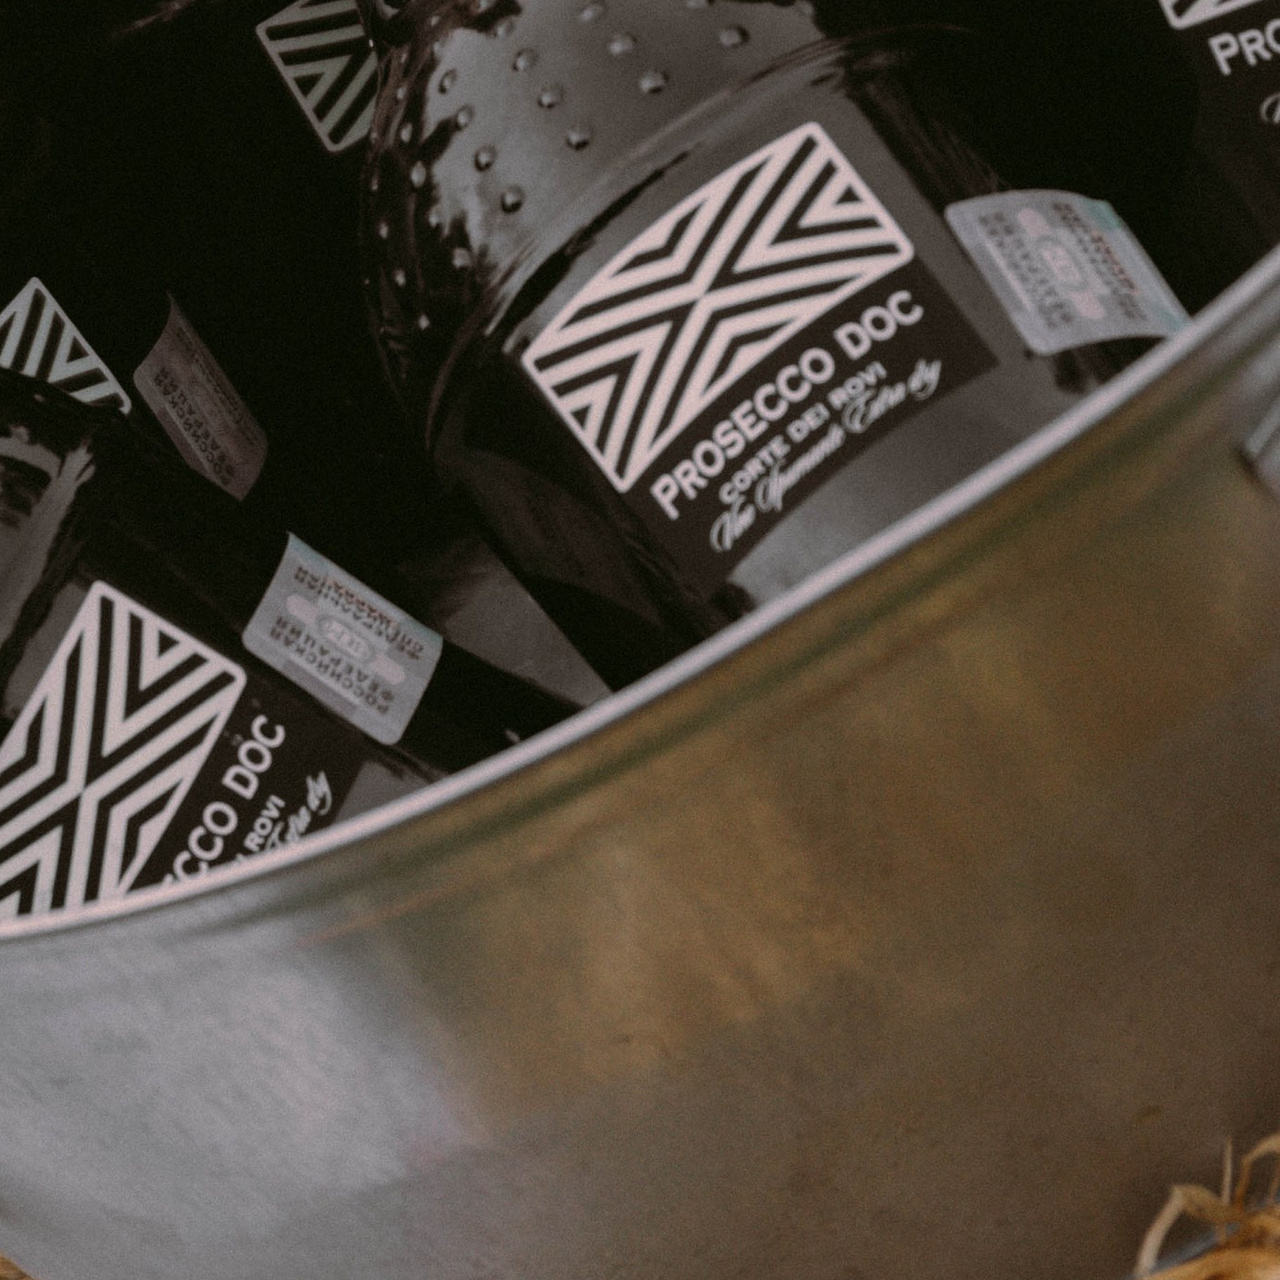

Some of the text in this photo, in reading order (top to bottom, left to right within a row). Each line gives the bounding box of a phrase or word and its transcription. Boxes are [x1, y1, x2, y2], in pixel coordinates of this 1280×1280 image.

[651, 291, 923, 519] PROSECCO DOC
[720, 362, 886, 504] CORTE DEI ROVI
[266, 625, 391, 716] РОССИЙСКАЯ
[272, 614, 396, 704] ФЕДЕРАЦИЯ
[222, 715, 285, 799] DOC
[244, 796, 284, 855] ROVI
